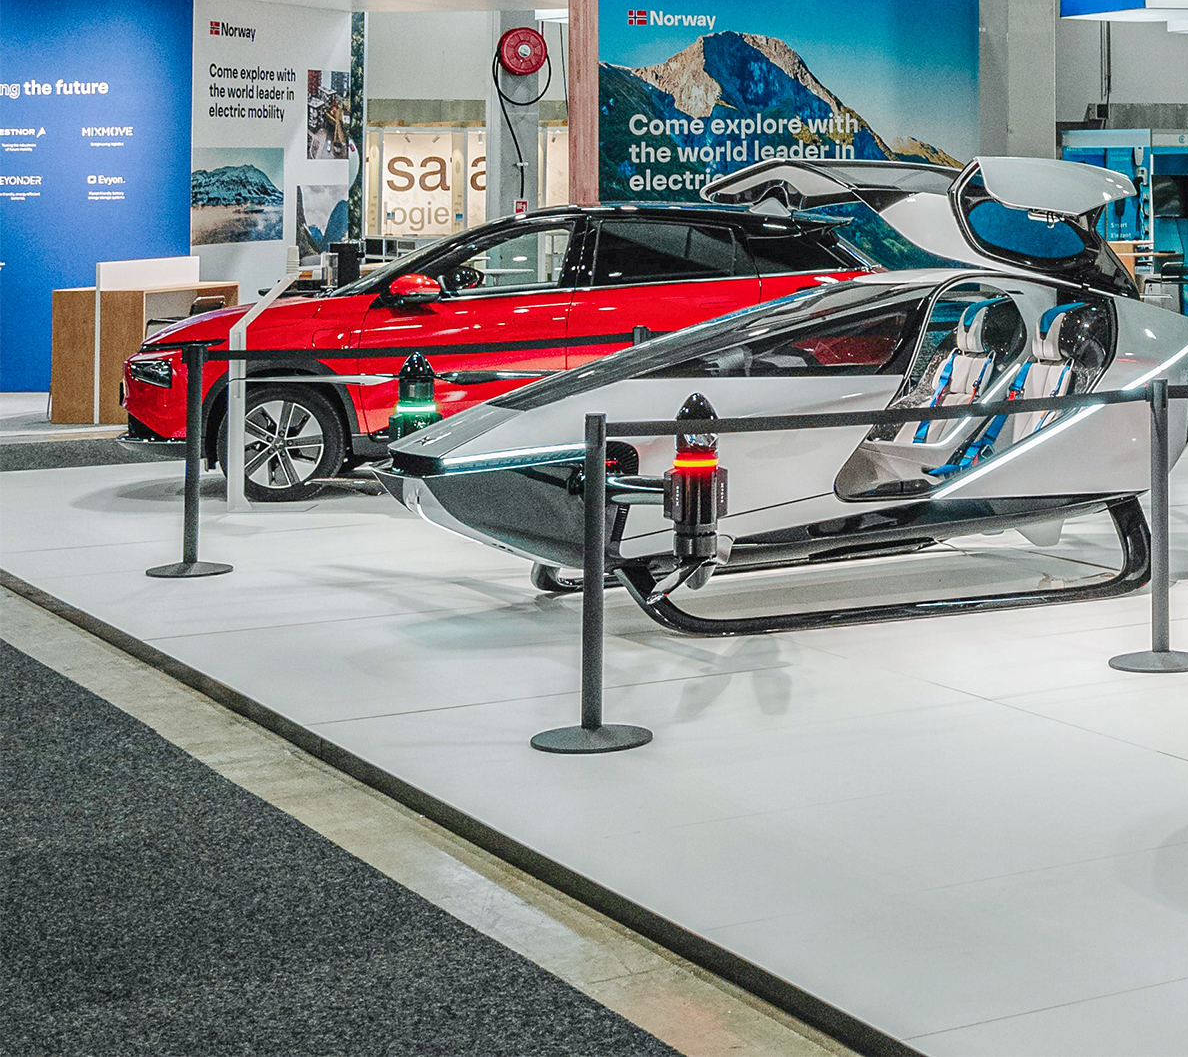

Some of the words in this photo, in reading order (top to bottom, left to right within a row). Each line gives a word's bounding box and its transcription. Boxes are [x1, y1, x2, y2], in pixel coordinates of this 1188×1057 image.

[650, 10, 716, 30] Norway
[221, 22, 256, 42] Norway
[209, 63, 239, 79] Come
[240, 66, 275, 84] explore
[276, 68, 297, 82] with
[23, 79, 52, 95] the
[55, 79, 109, 95] future
[209, 84, 225, 98] the
[227, 85, 254, 99] world
[256, 86, 285, 101] leader
[286, 87, 295, 101] in
[209, 103, 246, 118] electric
[247, 104, 285, 122] mobility
[81, 127, 134, 137] MIXMOVE
[628, 114, 705, 136] Come
[710, 113, 802, 139] explore
[807, 112, 859, 133] with
[628, 141, 671, 163] the
[677, 140, 747, 163] world
[754, 140, 829, 160] leader
[835, 139, 855, 160] in
